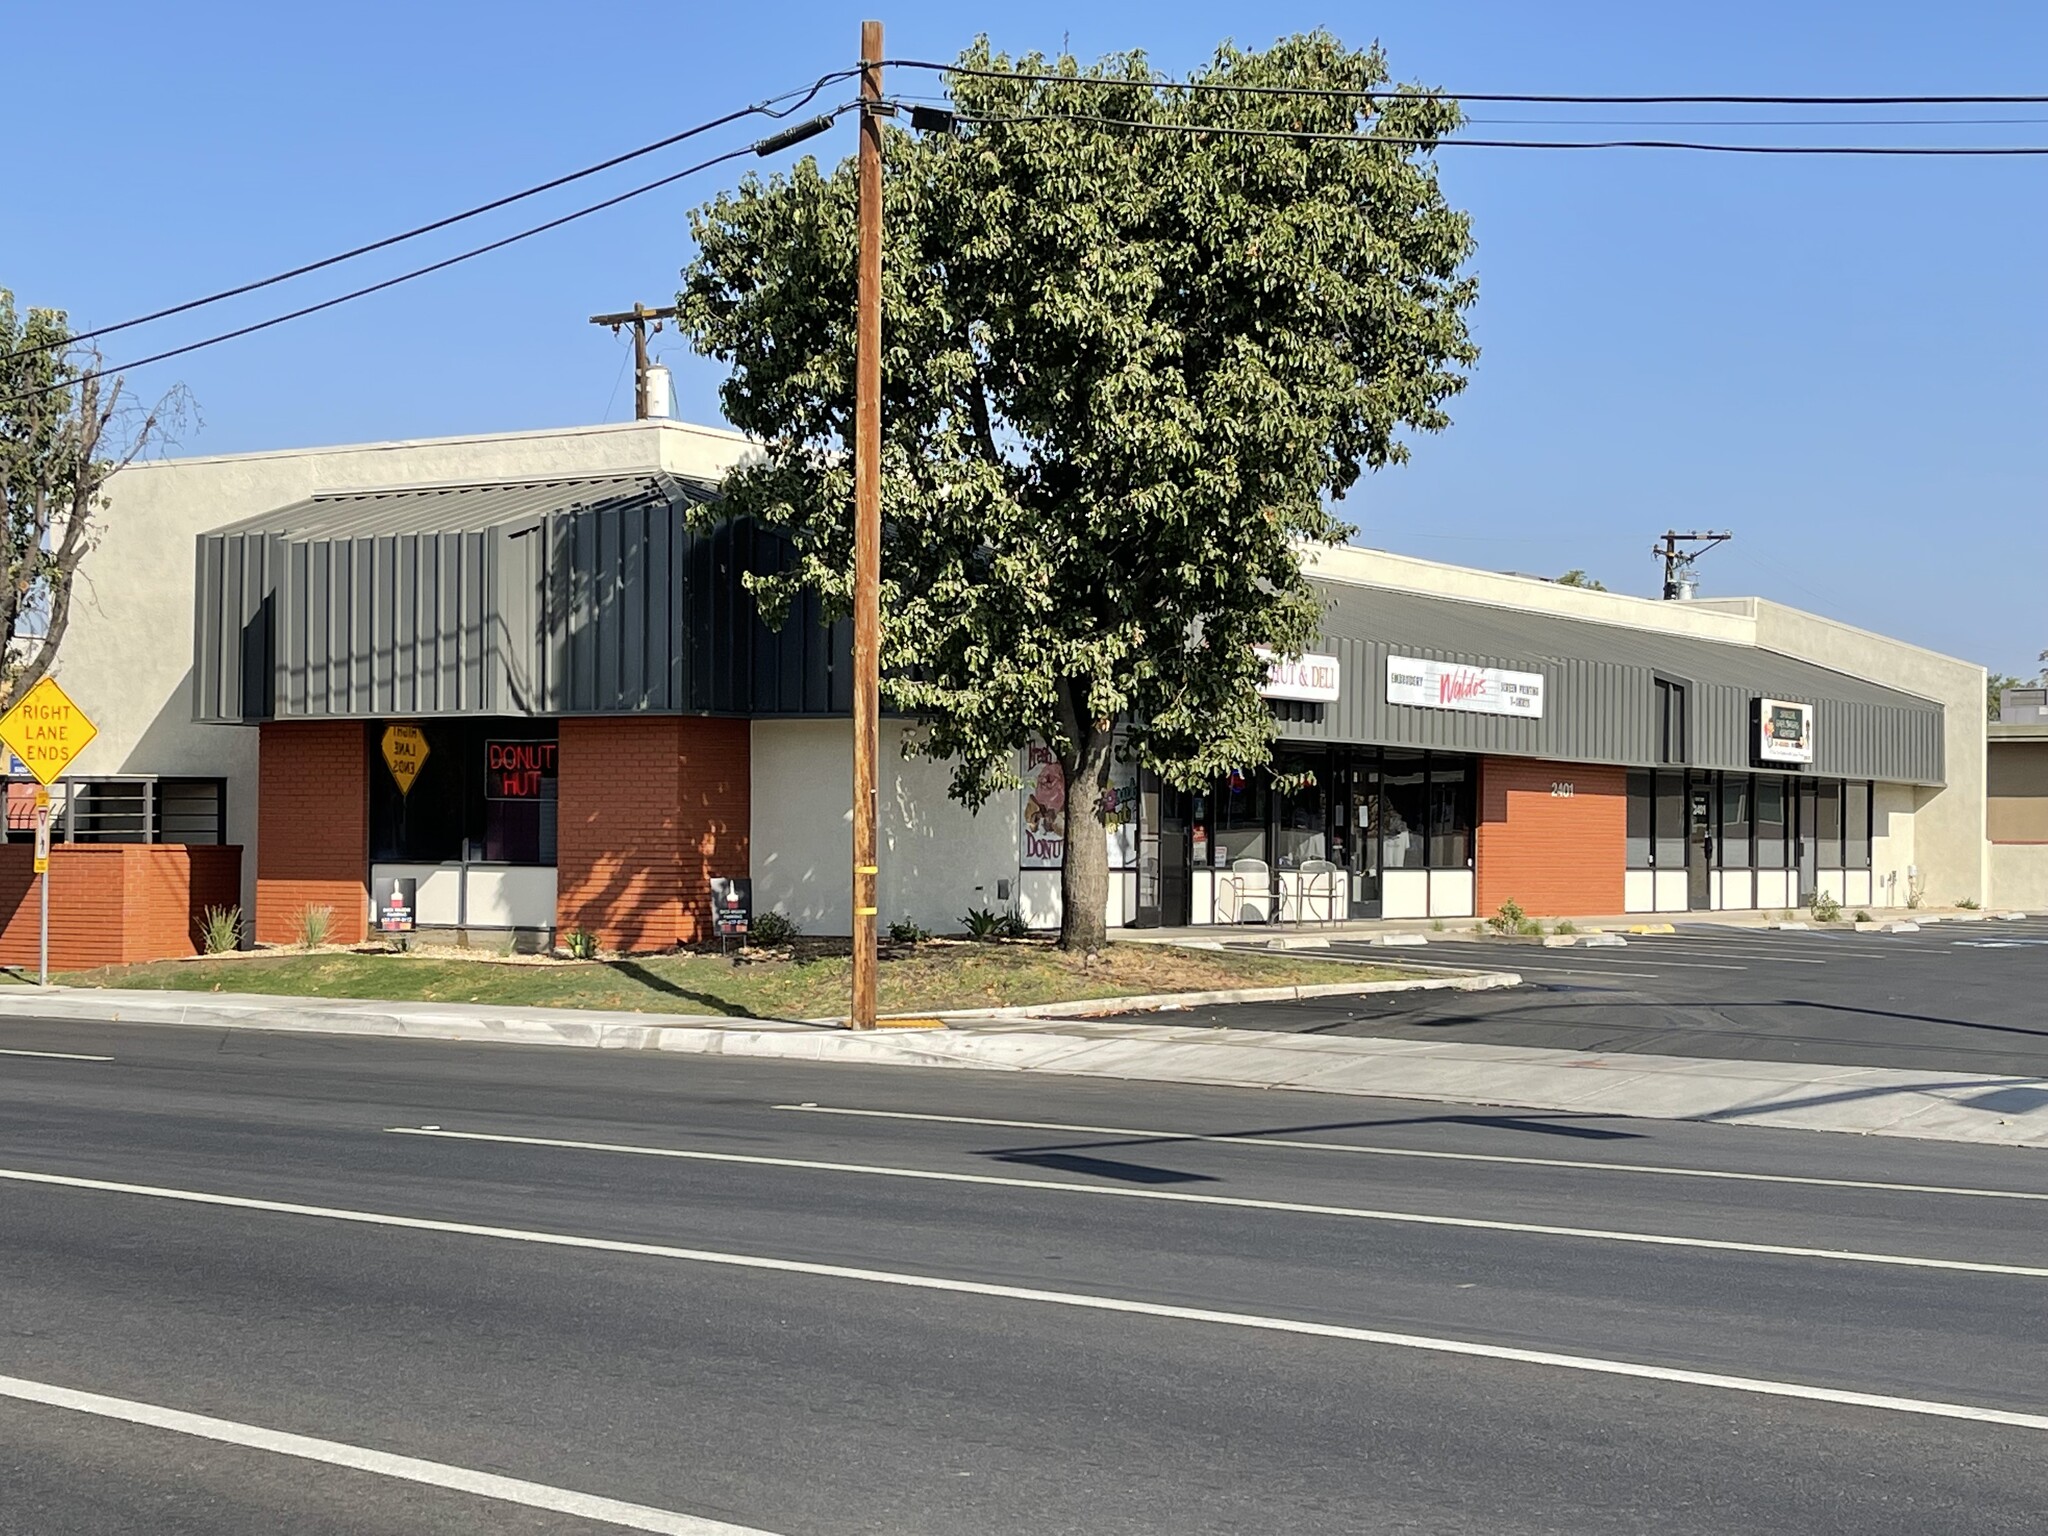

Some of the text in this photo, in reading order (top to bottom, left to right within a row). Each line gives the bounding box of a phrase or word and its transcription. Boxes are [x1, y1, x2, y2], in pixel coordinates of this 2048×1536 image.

[1272, 663, 1335, 689] HUT & DELI
[1439, 666, 1487, 704] Waldo's
[23, 705, 70, 720] RIGHT
[26, 726, 68, 740] LANE
[27, 746, 69, 761] ENDS
[490, 745, 556, 769] DONUT
[503, 771, 541, 796] HUT
[1551, 782, 1574, 798] 2401
[1025, 829, 1063, 860] DONU
